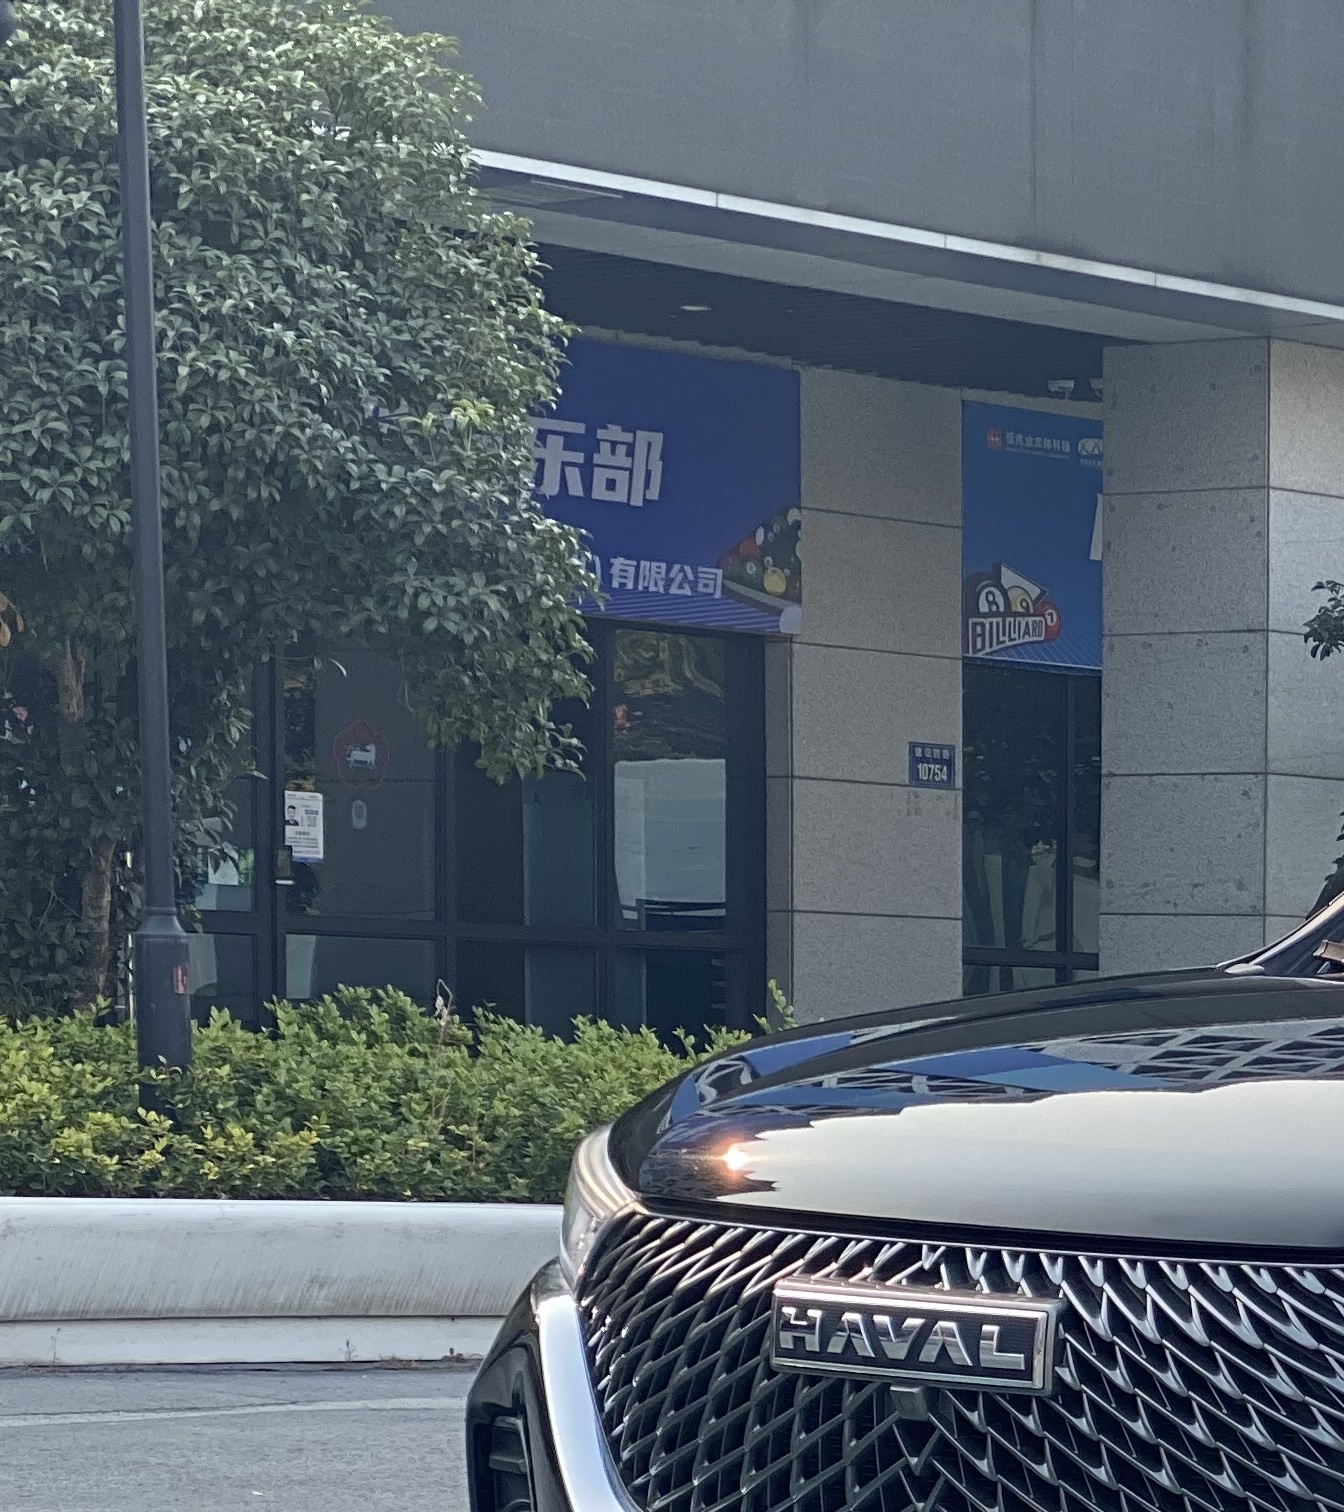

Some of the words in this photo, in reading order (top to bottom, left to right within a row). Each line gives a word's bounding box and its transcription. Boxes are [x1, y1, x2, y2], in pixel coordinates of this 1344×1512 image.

[971, 619, 1044, 653] BILLIARD
[917, 763, 948, 782] 10754
[778, 1305, 1027, 1371] HAVAL
